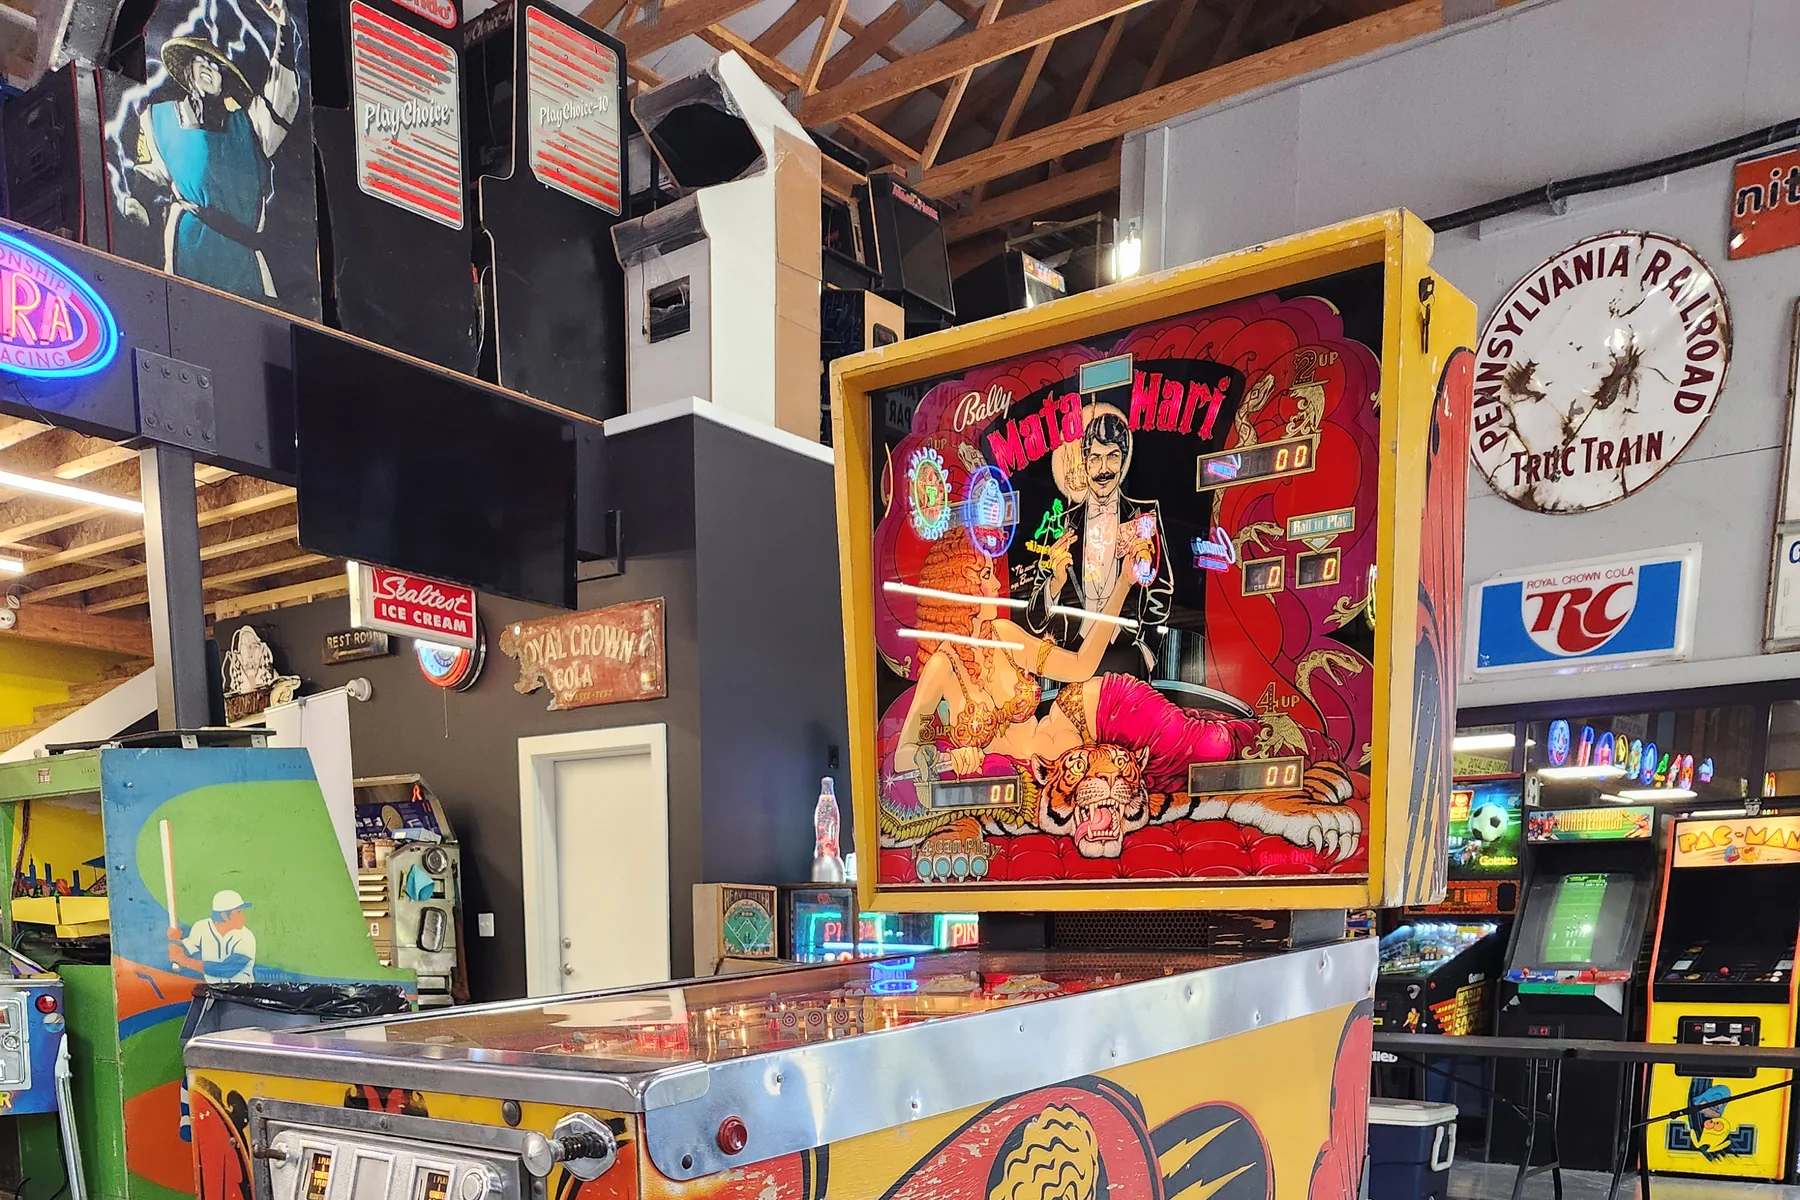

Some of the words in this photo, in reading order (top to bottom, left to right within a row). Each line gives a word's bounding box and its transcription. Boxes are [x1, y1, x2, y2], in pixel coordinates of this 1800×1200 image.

[364, 98, 450, 137] PlayChoice
[539, 94, 609, 128] PlayChoice-10
[1735, 165, 1800, 218] nit
[1318, 350, 1339, 367] UP
[1473, 245, 1629, 454] PENNSYLVANIA
[953, 384, 1012, 433] Bally
[986, 390, 1085, 478] Mata
[1127, 368, 1232, 440] Hari
[1292, 517, 1312, 535] Ball
[1314, 517, 1324, 531] in
[1326, 513, 1349, 531] Play
[1526, 577, 1558, 589] ROYAL
[1562, 570, 1601, 584] CROWN
[1605, 566, 1635, 580] COLA
[378, 575, 472, 616] Sealtest
[381, 602, 407, 620] ICE
[413, 610, 467, 633] CREAM
[1525, 580, 1634, 653] RC
[327, 633, 351, 649] REST
[570, 623, 638, 664] CROWN
[554, 662, 594, 692] COLA
[1255, 681, 1279, 714] 4
[1281, 694, 1301, 708] UP
[918, 714, 935, 742] 3
[1559, 809, 1624, 833] QUARTERBACK
[965, 837, 1003, 862] Play
[1259, 850, 1288, 865] Game
[1290, 849, 1314, 865] Over
